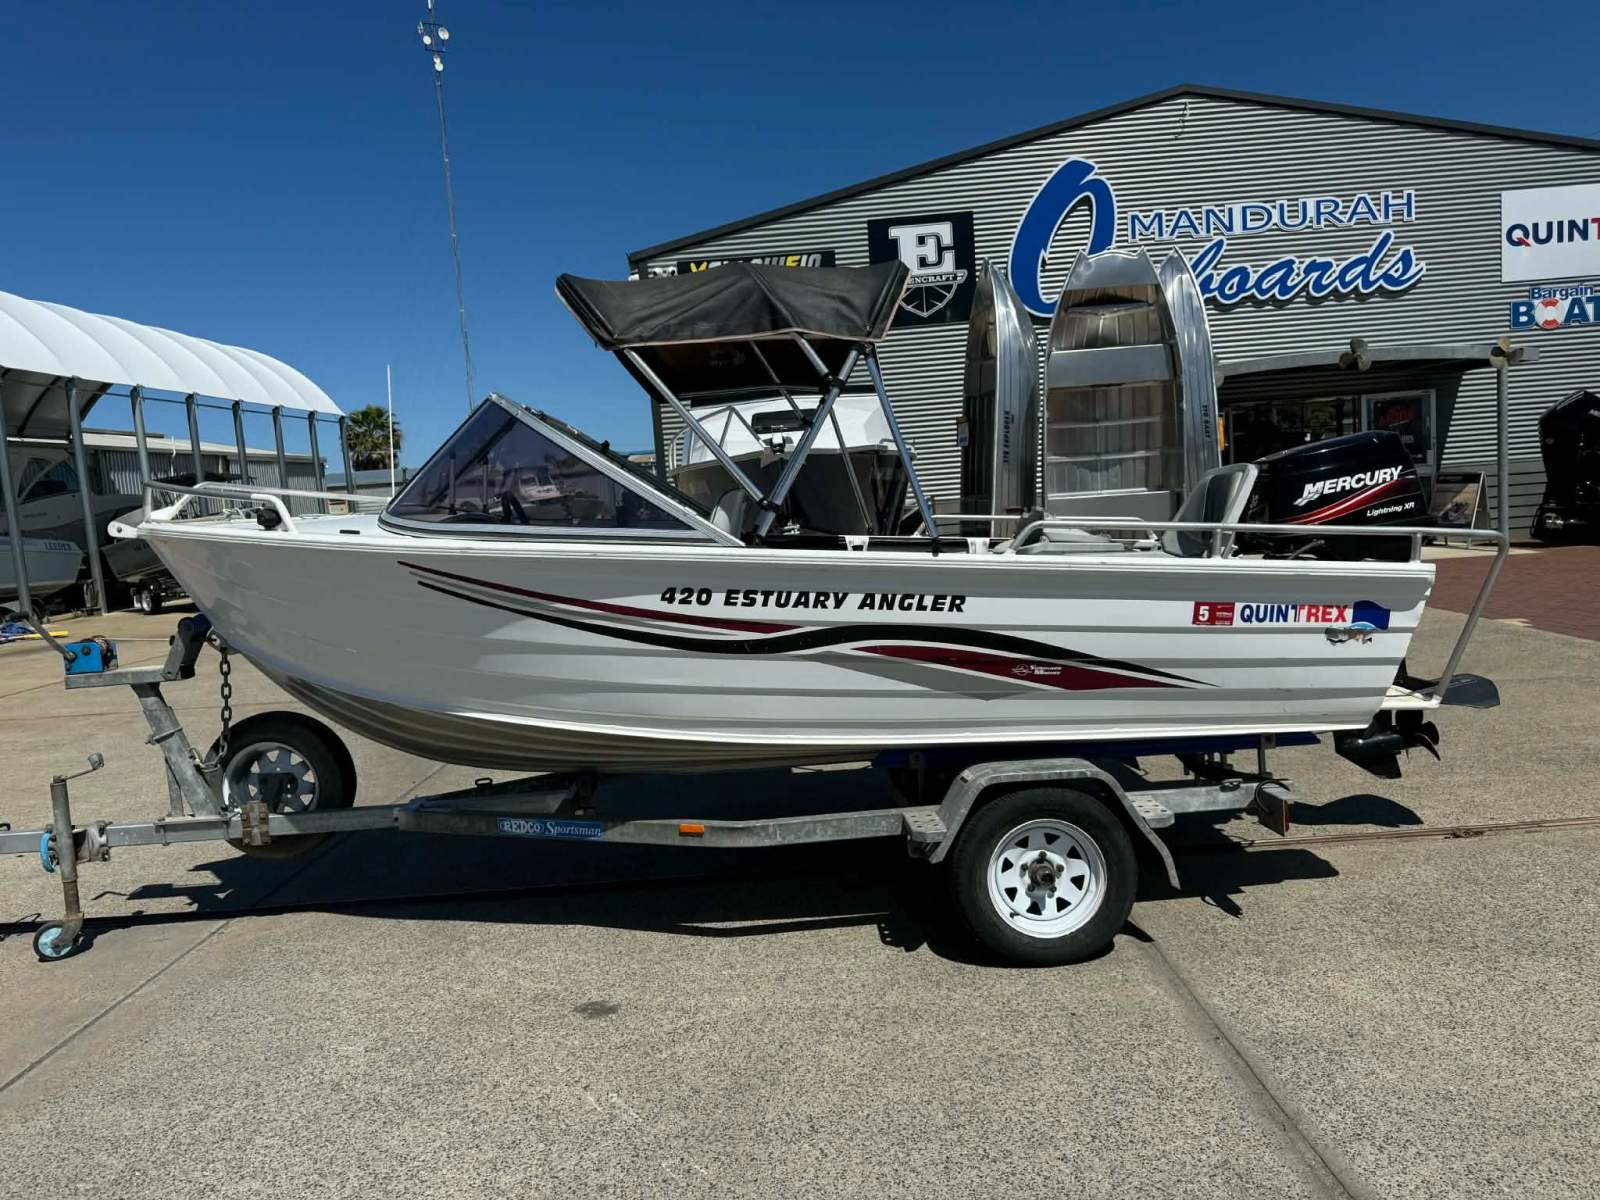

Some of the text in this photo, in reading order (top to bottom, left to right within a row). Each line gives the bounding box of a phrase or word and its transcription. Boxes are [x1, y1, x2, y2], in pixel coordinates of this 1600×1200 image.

[1127, 190, 1416, 243] MANDURAH
[1530, 285, 1594, 300] Bargain
[1293, 466, 1402, 506] MERCURY
[1366, 502, 1415, 517] Lightning XR
[660, 587, 967, 613] 420 ESTUARY ANGLER
[1199, 605, 1210, 621] 5
[1240, 604, 1348, 623] QUINTREX
[544, 821, 601, 836] Sportsman
